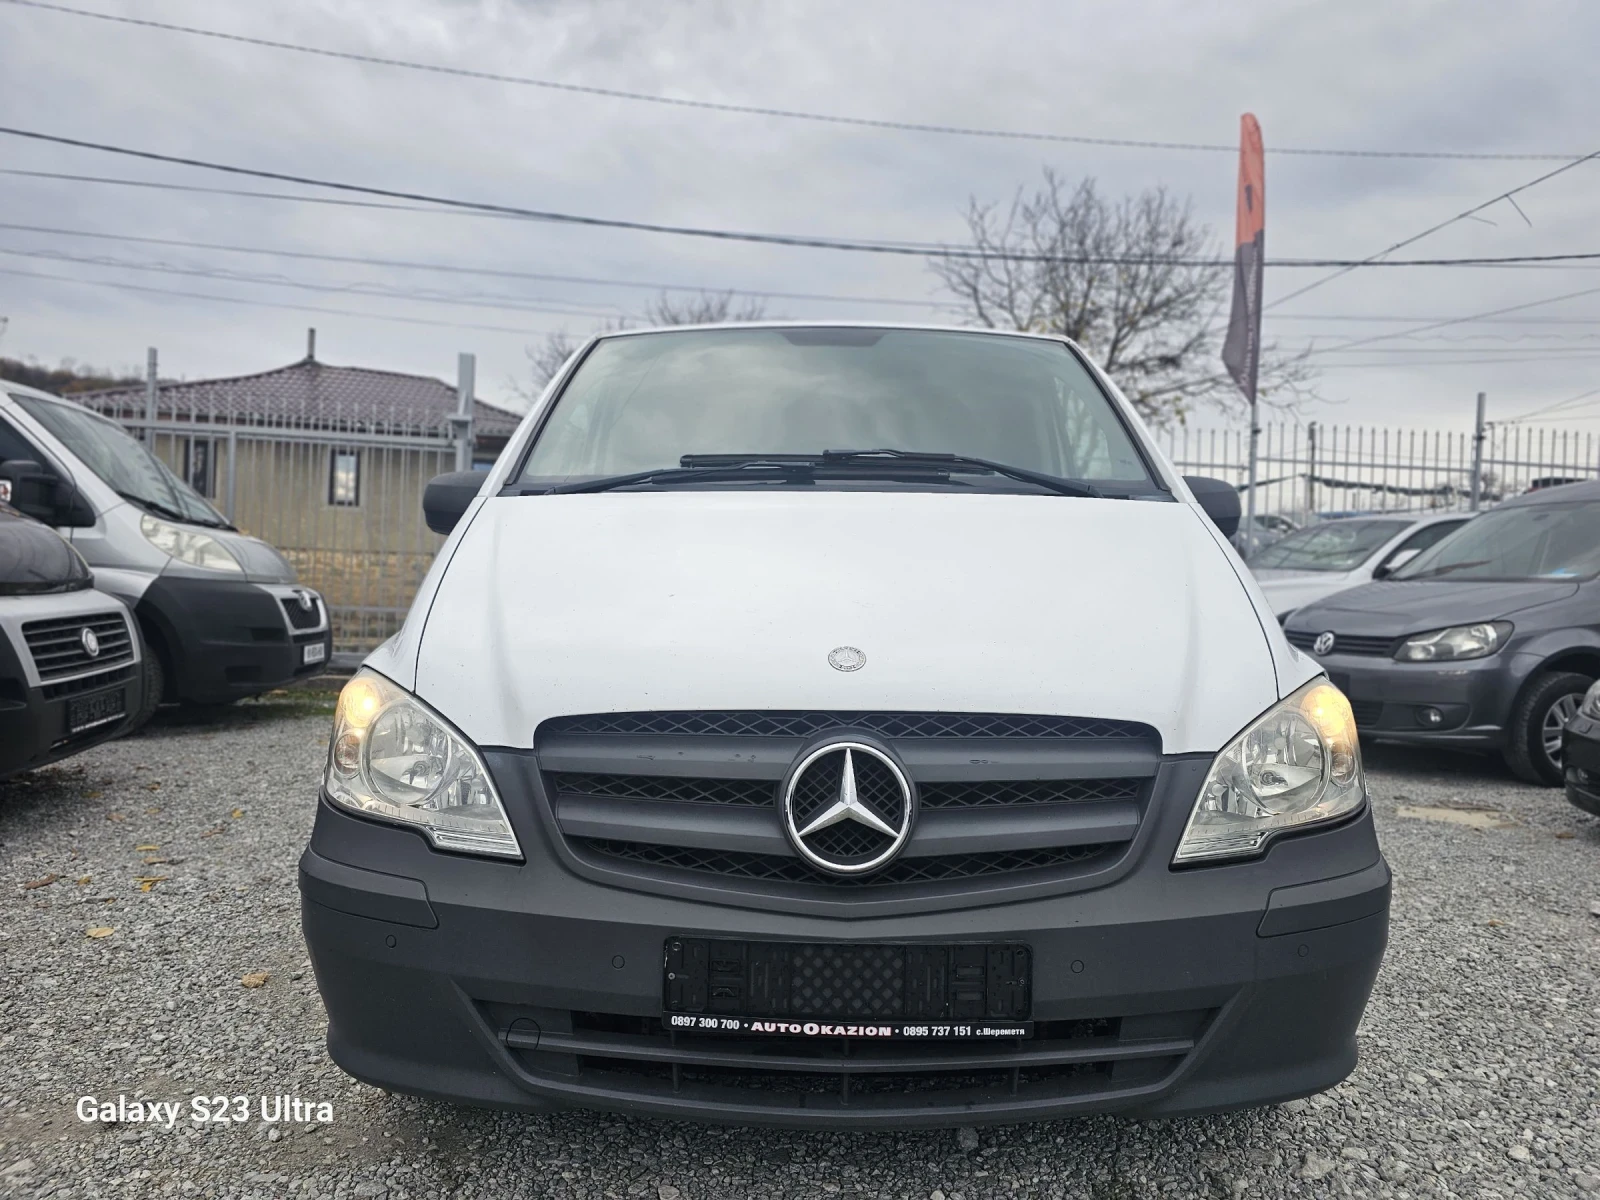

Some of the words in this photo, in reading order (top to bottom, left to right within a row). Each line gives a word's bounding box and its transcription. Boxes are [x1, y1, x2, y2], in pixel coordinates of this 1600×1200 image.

[671, 1015, 696, 1027] 0897
[698, 1017, 718, 1029] 300
[720, 1019, 740, 1030] 700
[751, 1022, 892, 1036] AUTOOKAZION
[903, 1026, 929, 1036] 0895
[931, 1026, 950, 1036] 737
[953, 1026, 971, 1036] 151
